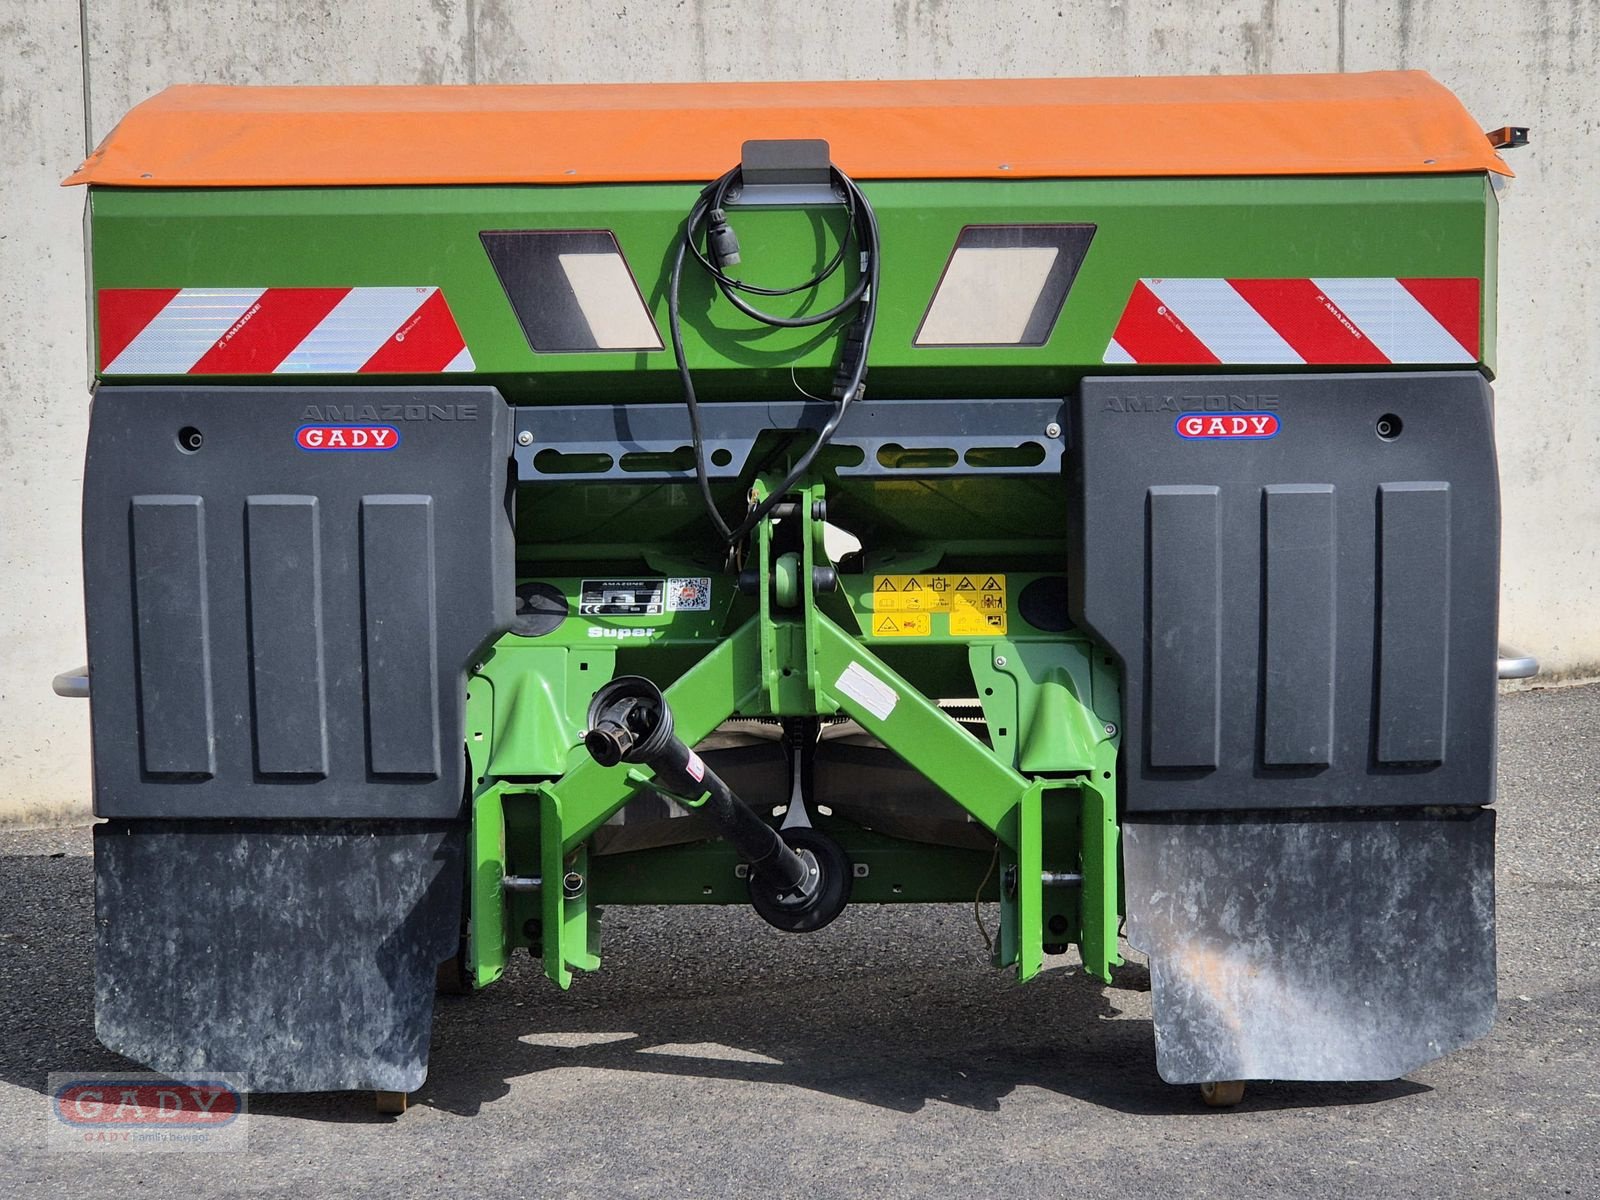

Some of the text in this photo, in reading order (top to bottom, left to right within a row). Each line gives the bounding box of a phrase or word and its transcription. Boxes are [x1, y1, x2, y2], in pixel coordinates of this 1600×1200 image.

[225, 303, 262, 341] AMAZONE
[1324, 303, 1362, 339] AMAZONE
[1101, 394, 1280, 413] AMAZONE
[300, 404, 478, 422] AMAZONE
[1185, 417, 1270, 435] GADY
[305, 429, 390, 447] GADY
[587, 626, 656, 640] Super
